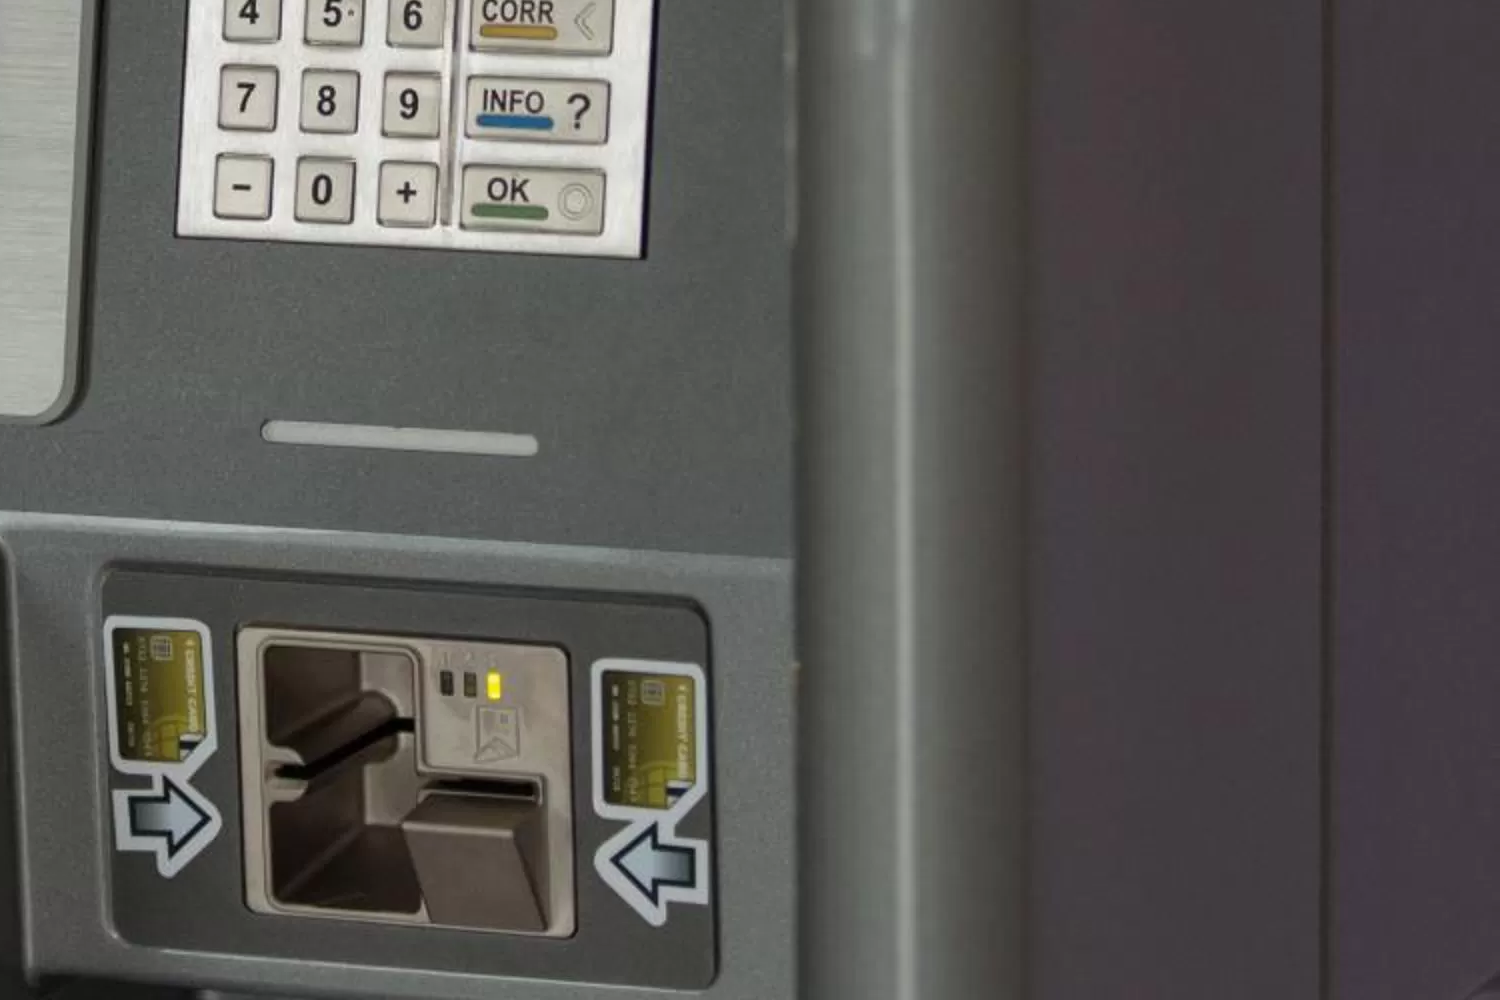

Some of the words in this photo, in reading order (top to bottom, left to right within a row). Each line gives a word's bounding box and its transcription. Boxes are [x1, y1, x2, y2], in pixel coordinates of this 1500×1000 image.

[402, 1, 423, 31] 6
[236, 83, 256, 114] 7
[316, 86, 337, 117] 8
[399, 90, 420, 120] 9
[483, 89, 545, 114] INFO
[311, 175, 332, 205] 0
[486, 178, 530, 203] OK
